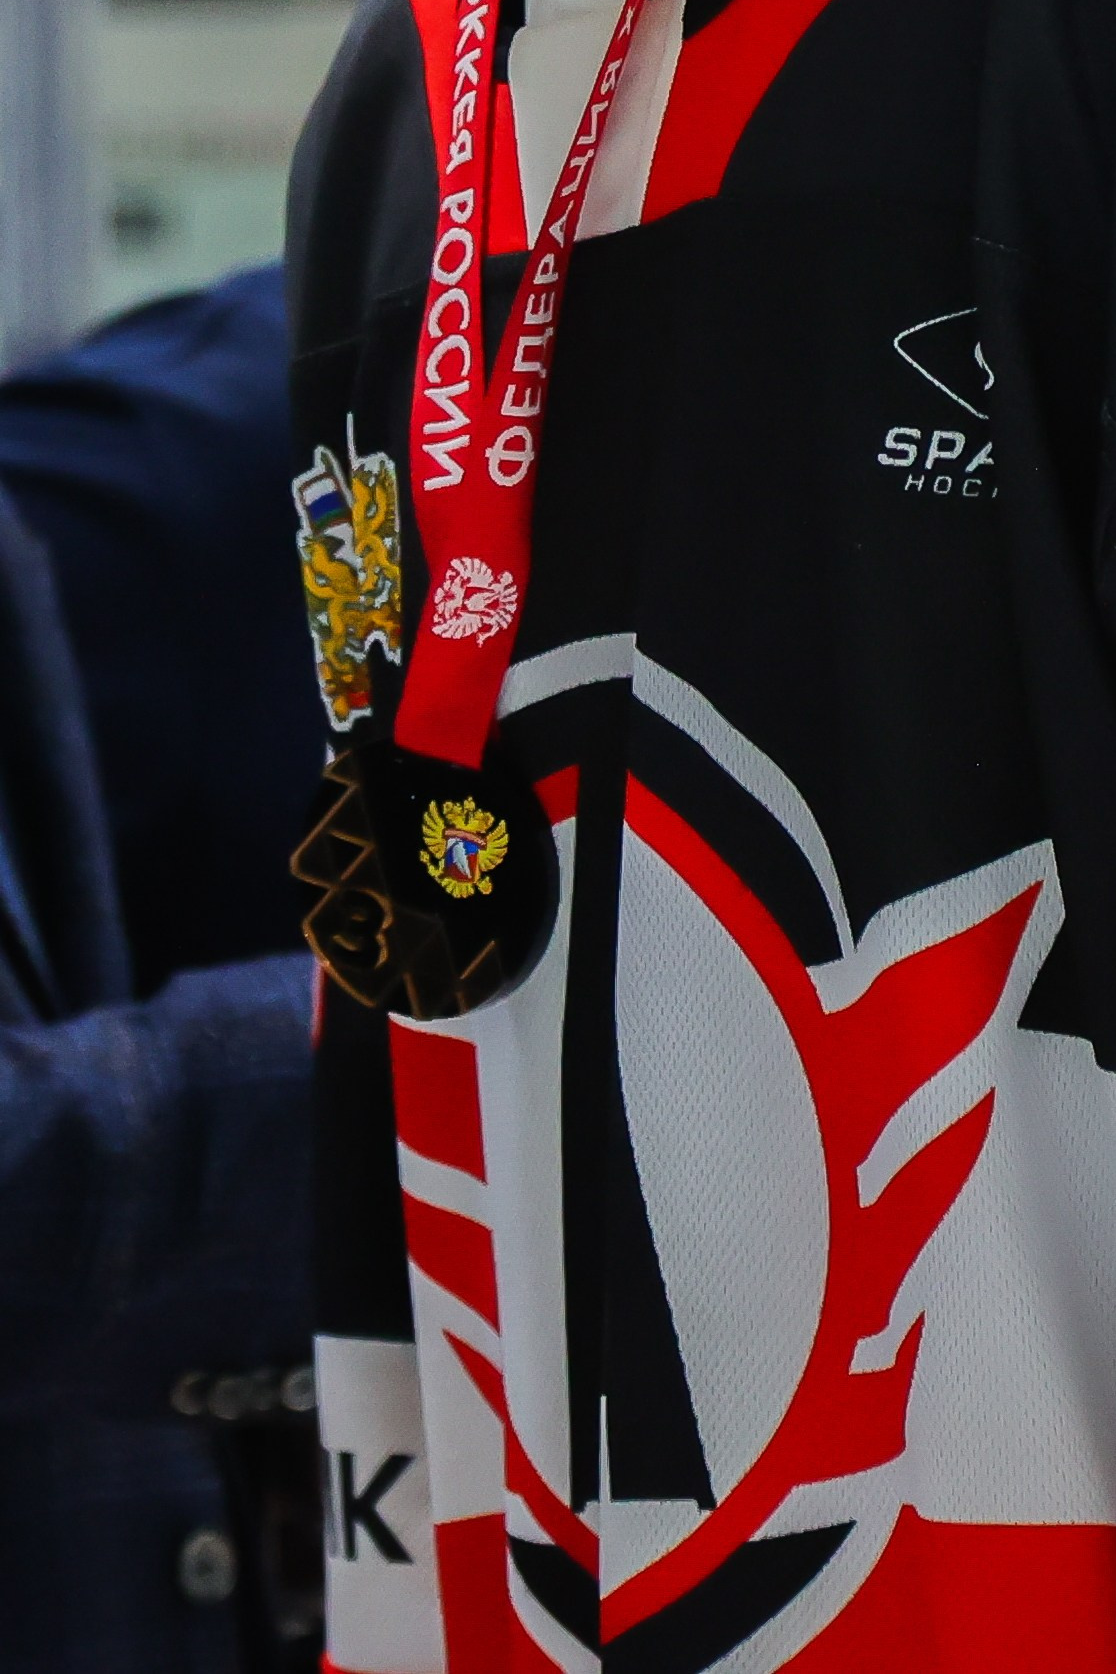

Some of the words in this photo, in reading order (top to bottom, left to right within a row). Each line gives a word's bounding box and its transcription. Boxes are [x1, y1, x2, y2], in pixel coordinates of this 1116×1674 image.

[421, 192, 476, 492] РОССИИ
[485, 58, 624, 487] ФЕДЕРАЦИЯ
[904, 474, 998, 499] HOC
[328, 1450, 414, 1566] К
